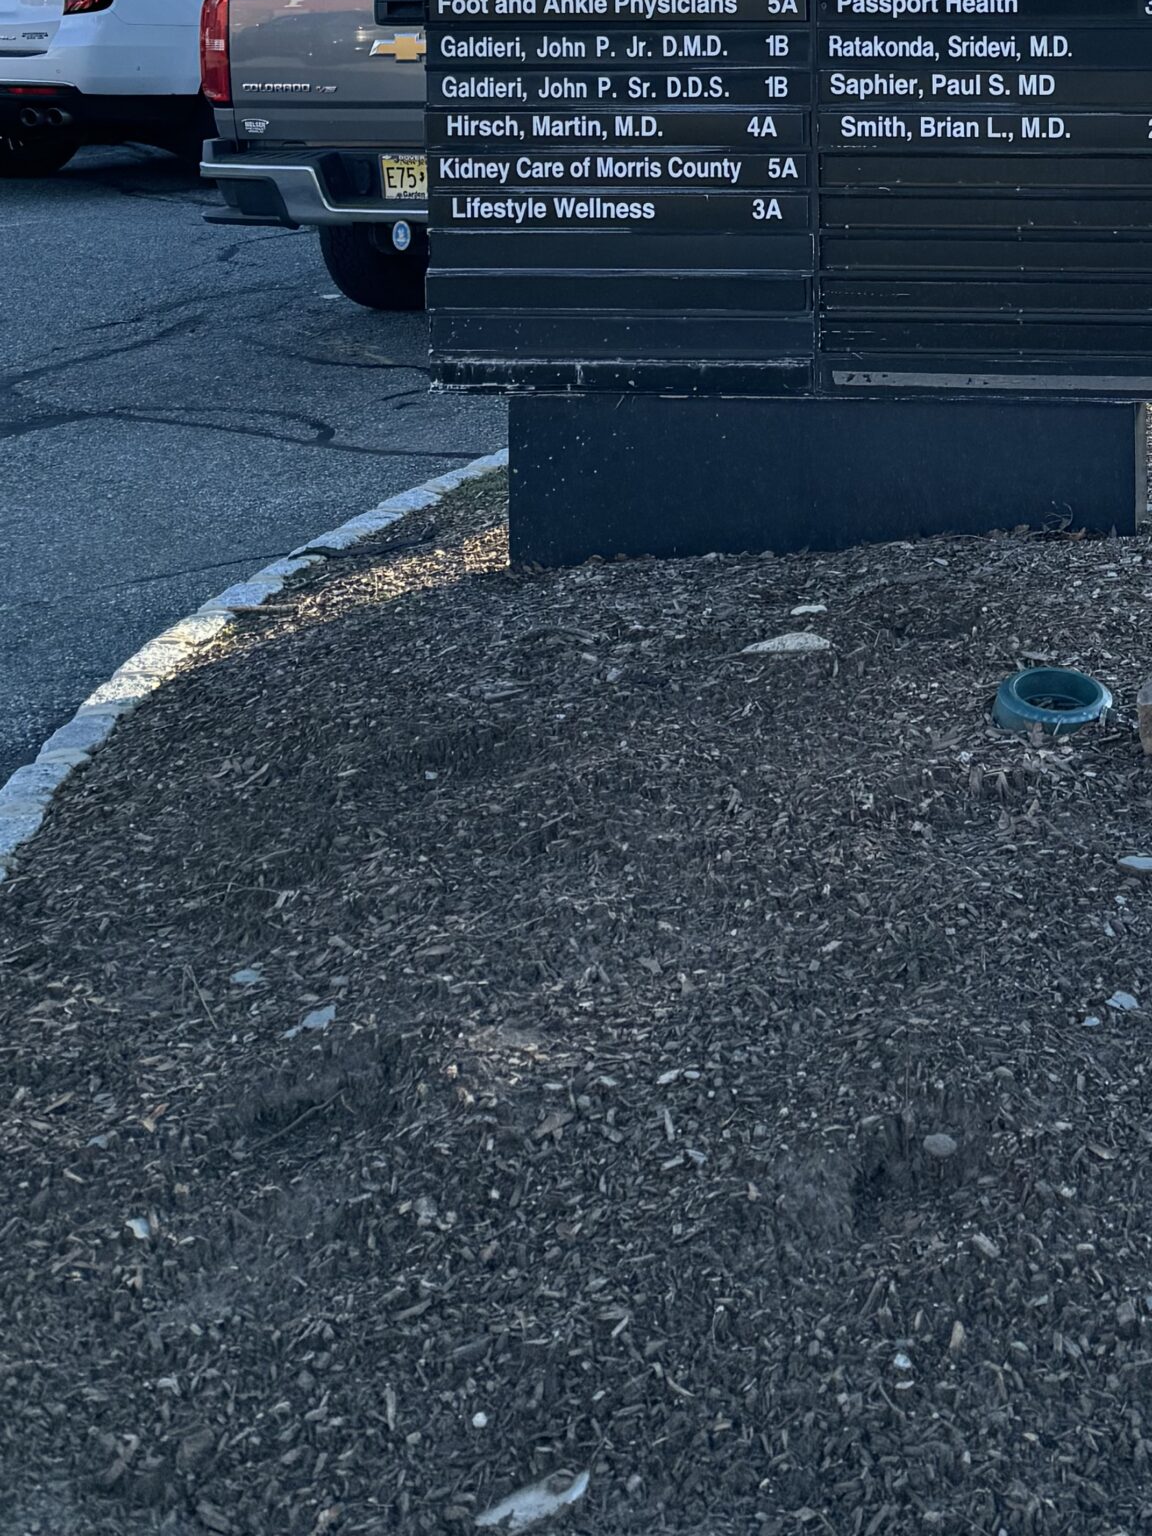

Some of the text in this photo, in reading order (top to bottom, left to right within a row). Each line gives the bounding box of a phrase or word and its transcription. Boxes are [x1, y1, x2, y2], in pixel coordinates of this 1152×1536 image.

[440, 34, 789, 62] Galdieri, John P. Jr. D.M.D. 1B
[828, 34, 940, 62] Ratakonda,
[947, 34, 1022, 62] Sridevi,
[1029, 35, 1073, 58] M.D.
[242, 83, 311, 93] COLORADO
[441, 75, 789, 103] Galdieri, John P. Sr. D.D.S. 1B
[830, 72, 924, 100] Saphier,
[931, 73, 981, 96] Paul
[988, 73, 1011, 96] S.
[1018, 74, 1056, 96] MD
[446, 114, 778, 141] Hirsch, Martin, M.D. 4A
[840, 115, 913, 142] Smith,
[920, 116, 980, 138] Brian
[987, 116, 1014, 143] L.,
[1021, 116, 1071, 139] M.D.
[439, 156, 799, 184] Kidney Care of Morris County 5A
[451, 196, 783, 224] Lifestyle Wellness 3A
